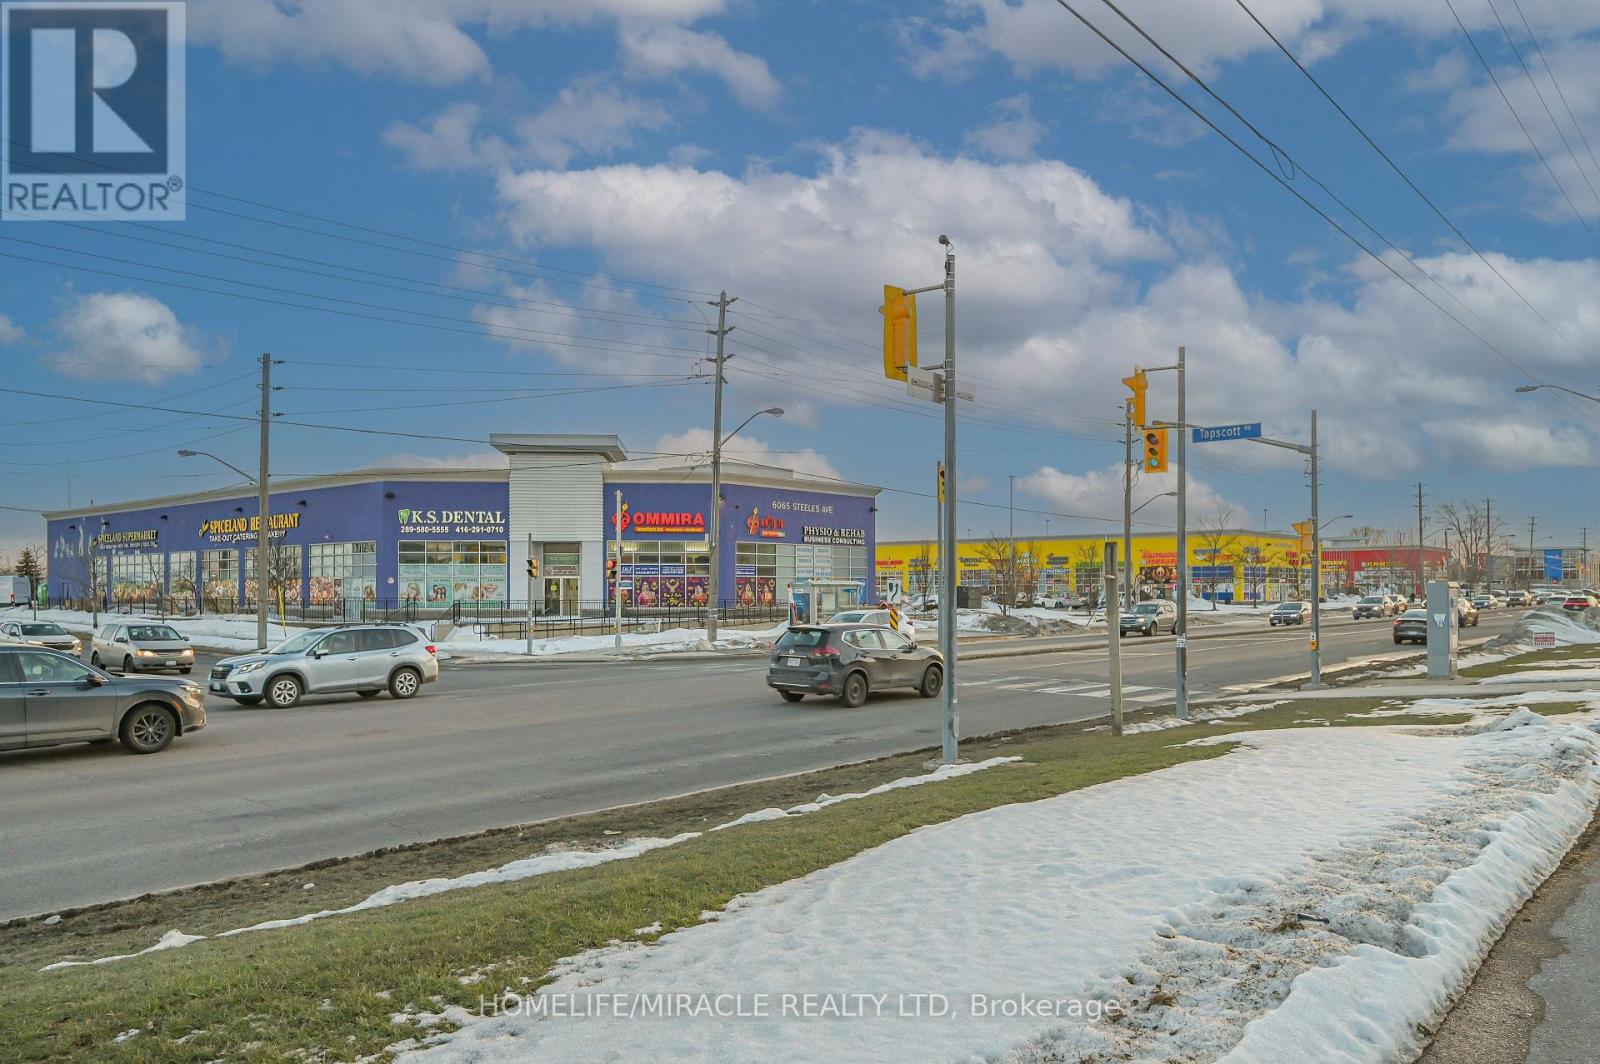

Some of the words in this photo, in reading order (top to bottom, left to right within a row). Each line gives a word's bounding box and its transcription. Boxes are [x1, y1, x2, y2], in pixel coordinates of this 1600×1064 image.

[1200, 426, 1241, 440] Tapscott
[772, 501, 791, 510] 6065
[793, 503, 820, 513] STEELES
[821, 506, 833, 514] AVE
[209, 517, 248, 534] SPICELAND
[250, 512, 300, 531] REAURANT
[412, 511, 439, 524] K.S.
[442, 511, 505, 524] DENTAL
[633, 512, 704, 526] OMMIRA
[804, 525, 832, 536] PHYSIO
[833, 528, 839, 537] &
[841, 528, 865, 538] REHAB
[832, 536, 865, 545] CONSULTING
